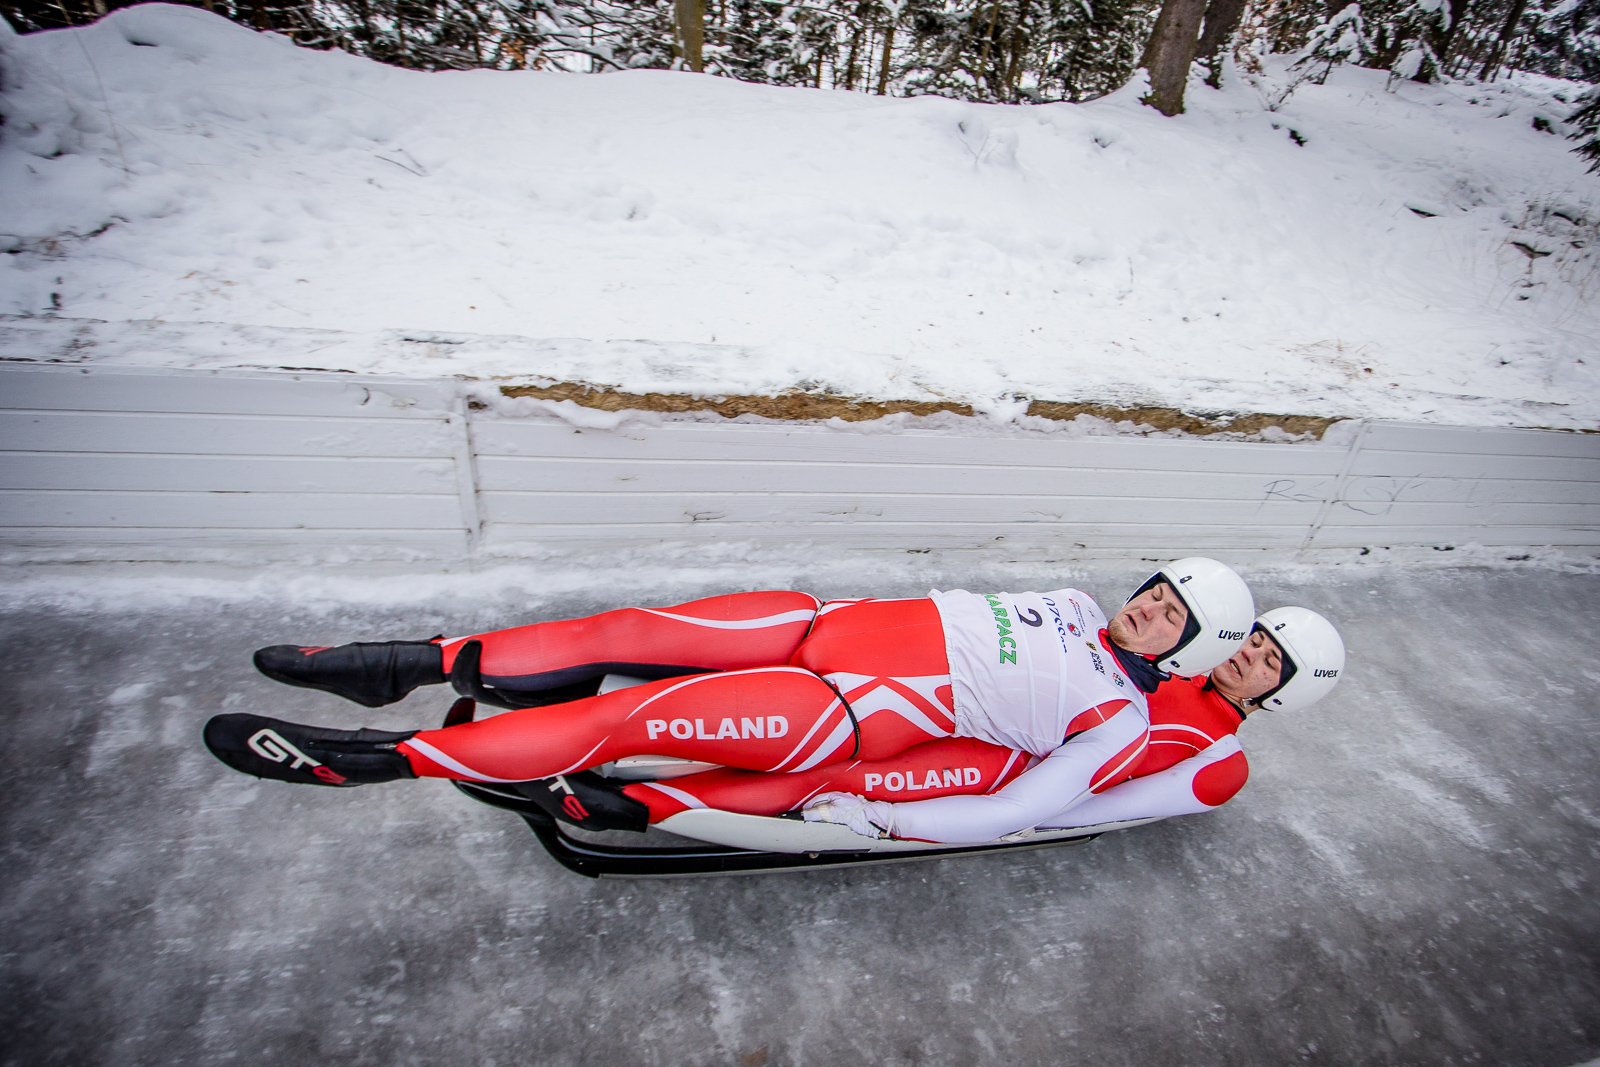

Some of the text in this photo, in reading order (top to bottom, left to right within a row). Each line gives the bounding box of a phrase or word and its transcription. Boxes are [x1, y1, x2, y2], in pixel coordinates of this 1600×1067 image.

[1013, 604, 1043, 628] 2
[1218, 629, 1246, 641] uvex
[1313, 668, 1339, 678] uvex
[645, 714, 790, 741] POLAND
[864, 766, 983, 793] POLAND
[548, 774, 591, 822] TS
